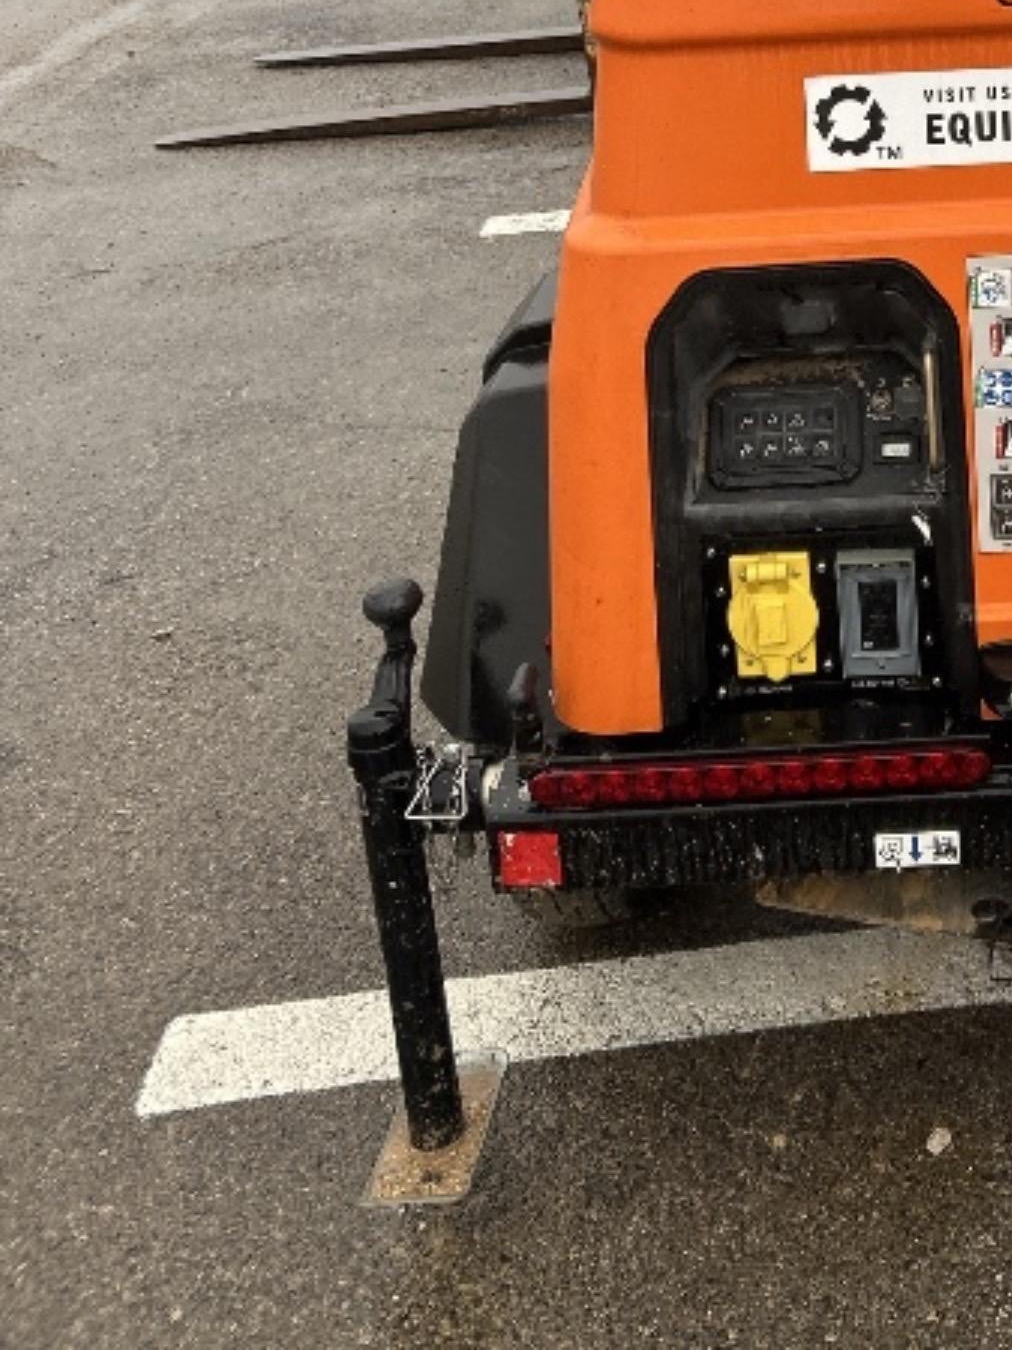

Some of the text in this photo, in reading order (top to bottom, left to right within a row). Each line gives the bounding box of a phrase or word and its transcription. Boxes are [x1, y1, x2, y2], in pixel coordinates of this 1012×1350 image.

[923, 86, 976, 103] VISIT
[986, 85, 1011, 100] US
[876, 146, 903, 160] TM
